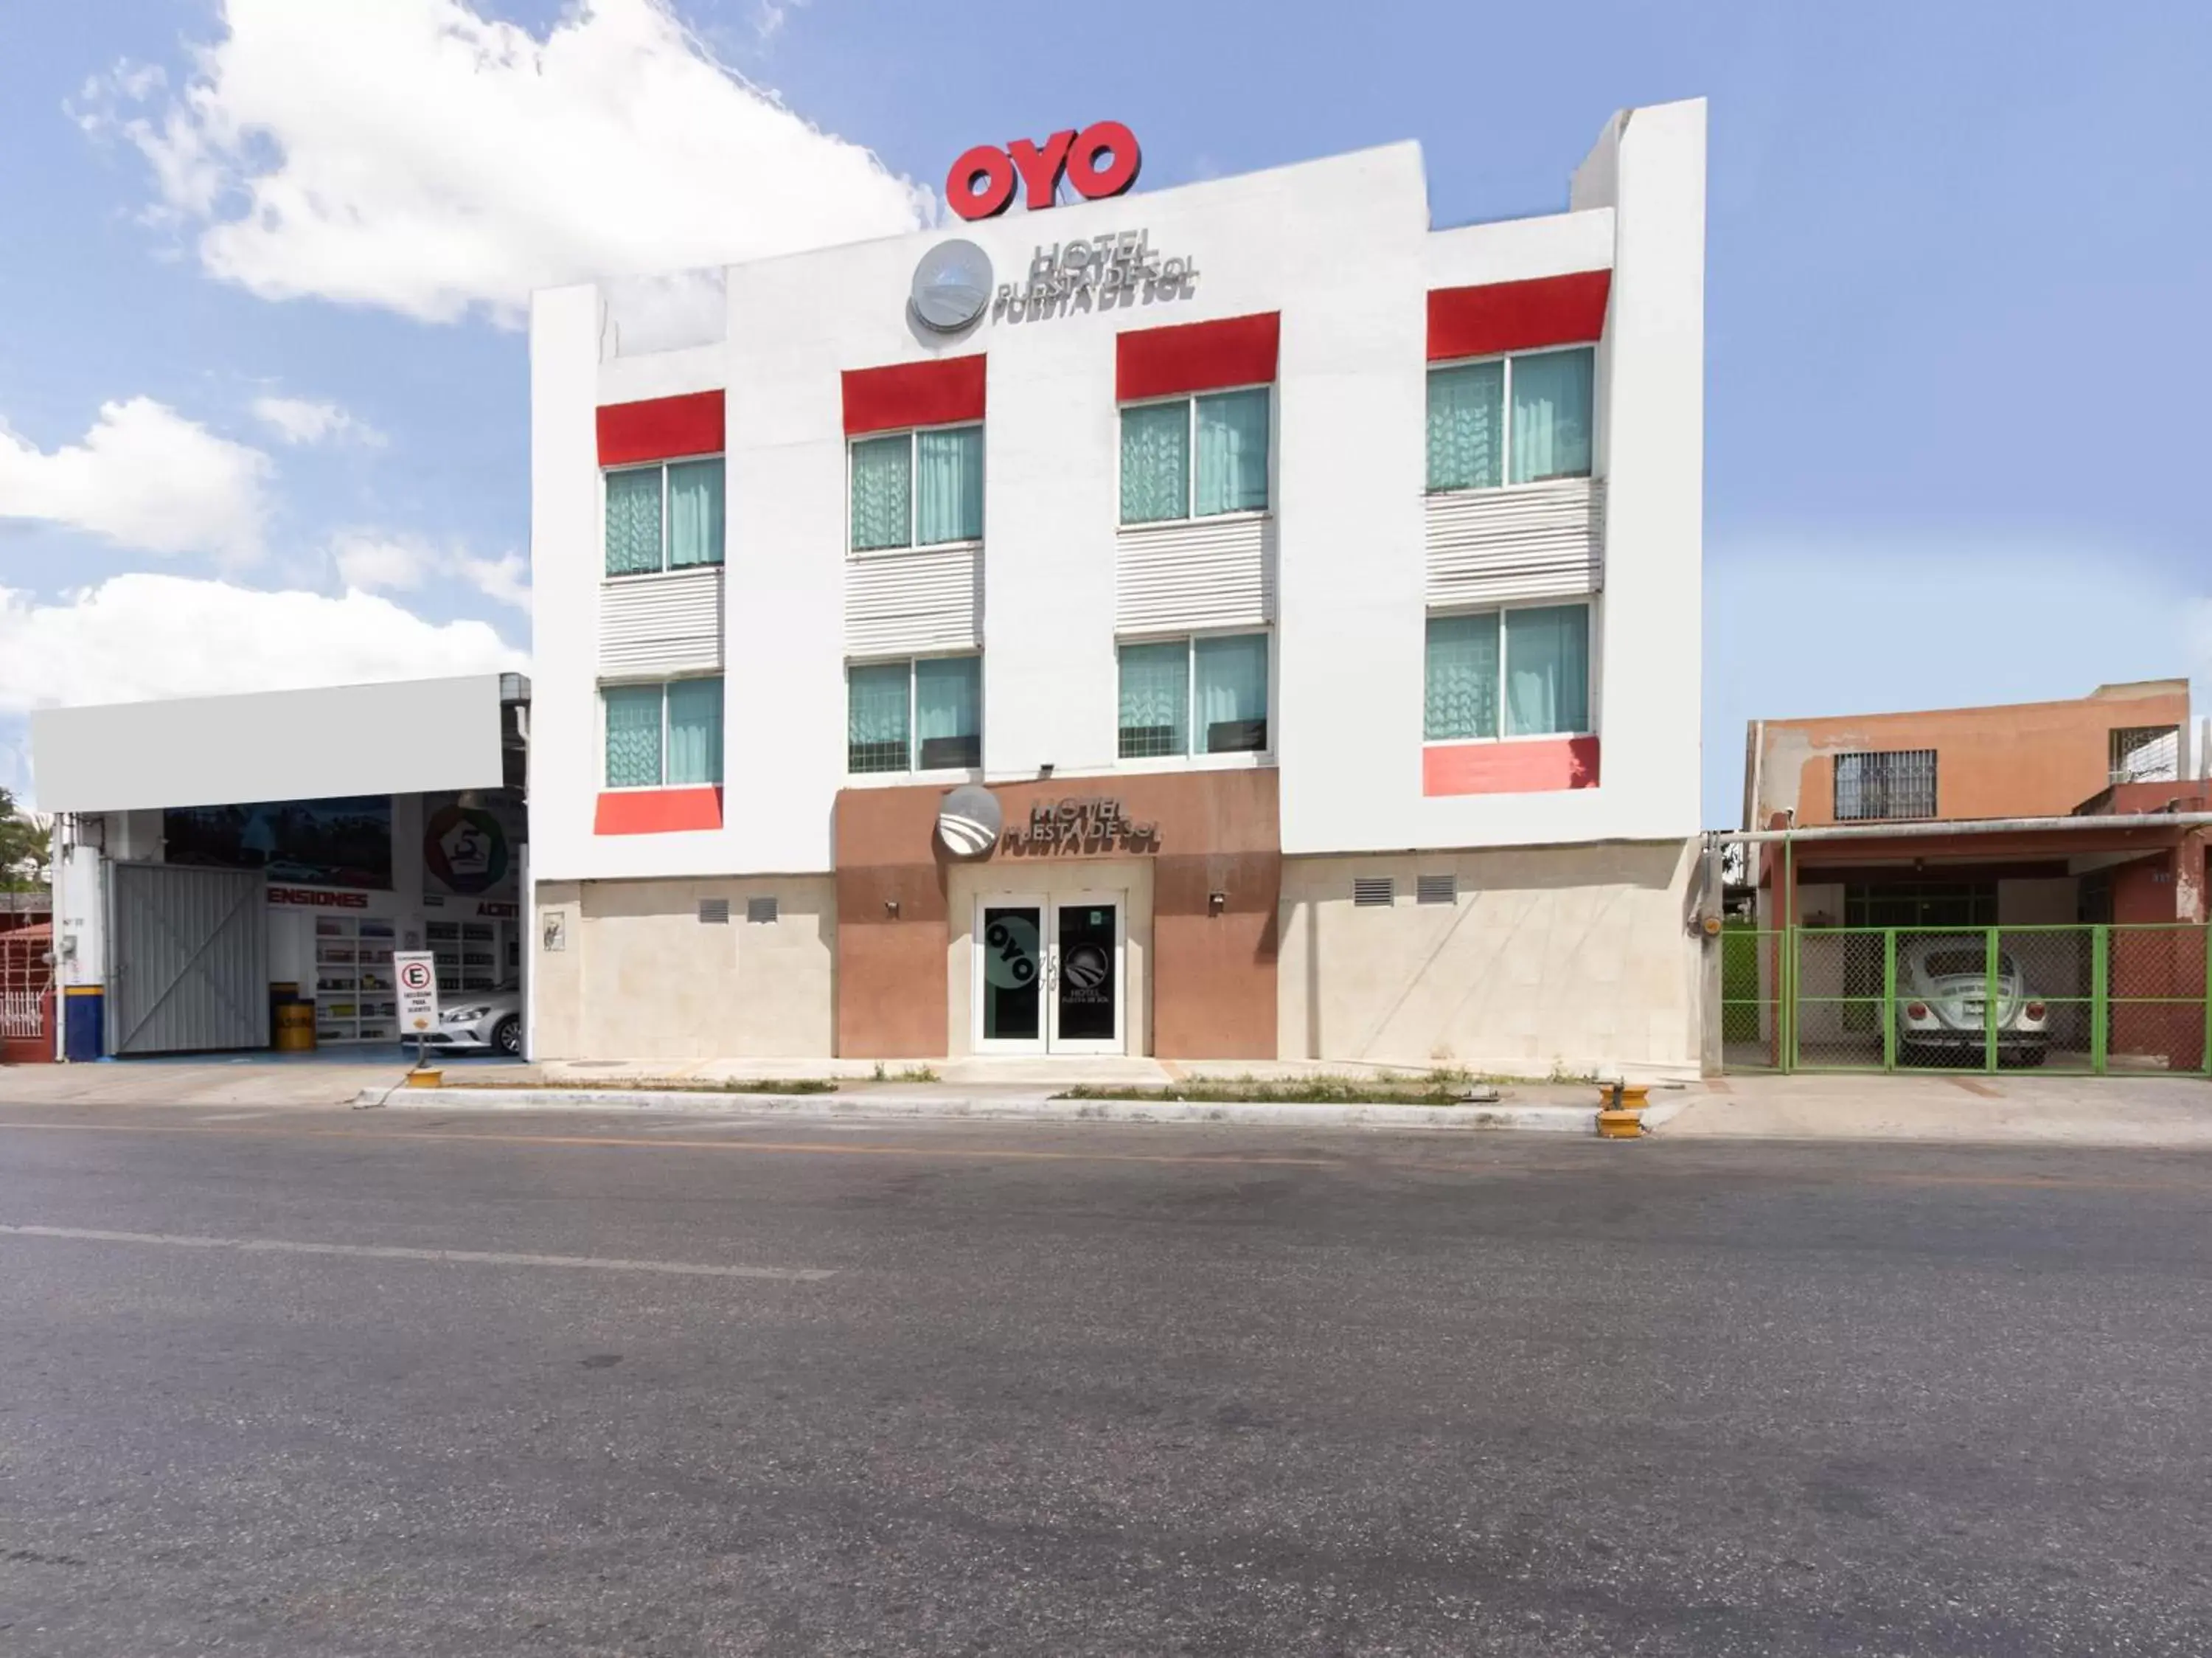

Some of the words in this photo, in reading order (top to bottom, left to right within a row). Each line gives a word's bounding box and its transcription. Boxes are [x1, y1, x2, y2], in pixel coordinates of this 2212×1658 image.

[945, 120, 1141, 223] OYO
[1034, 228, 1160, 271] HOTEL
[998, 270, 1094, 302] PUESTA
[1104, 266, 1138, 288] DE
[1150, 256, 1200, 282] SOL
[1034, 797, 1131, 820] HOTEL
[1090, 822, 1119, 838] DE
[1124, 820, 1164, 842] SOL
[987, 923, 1034, 981] OYO
[410, 968, 423, 984] E
